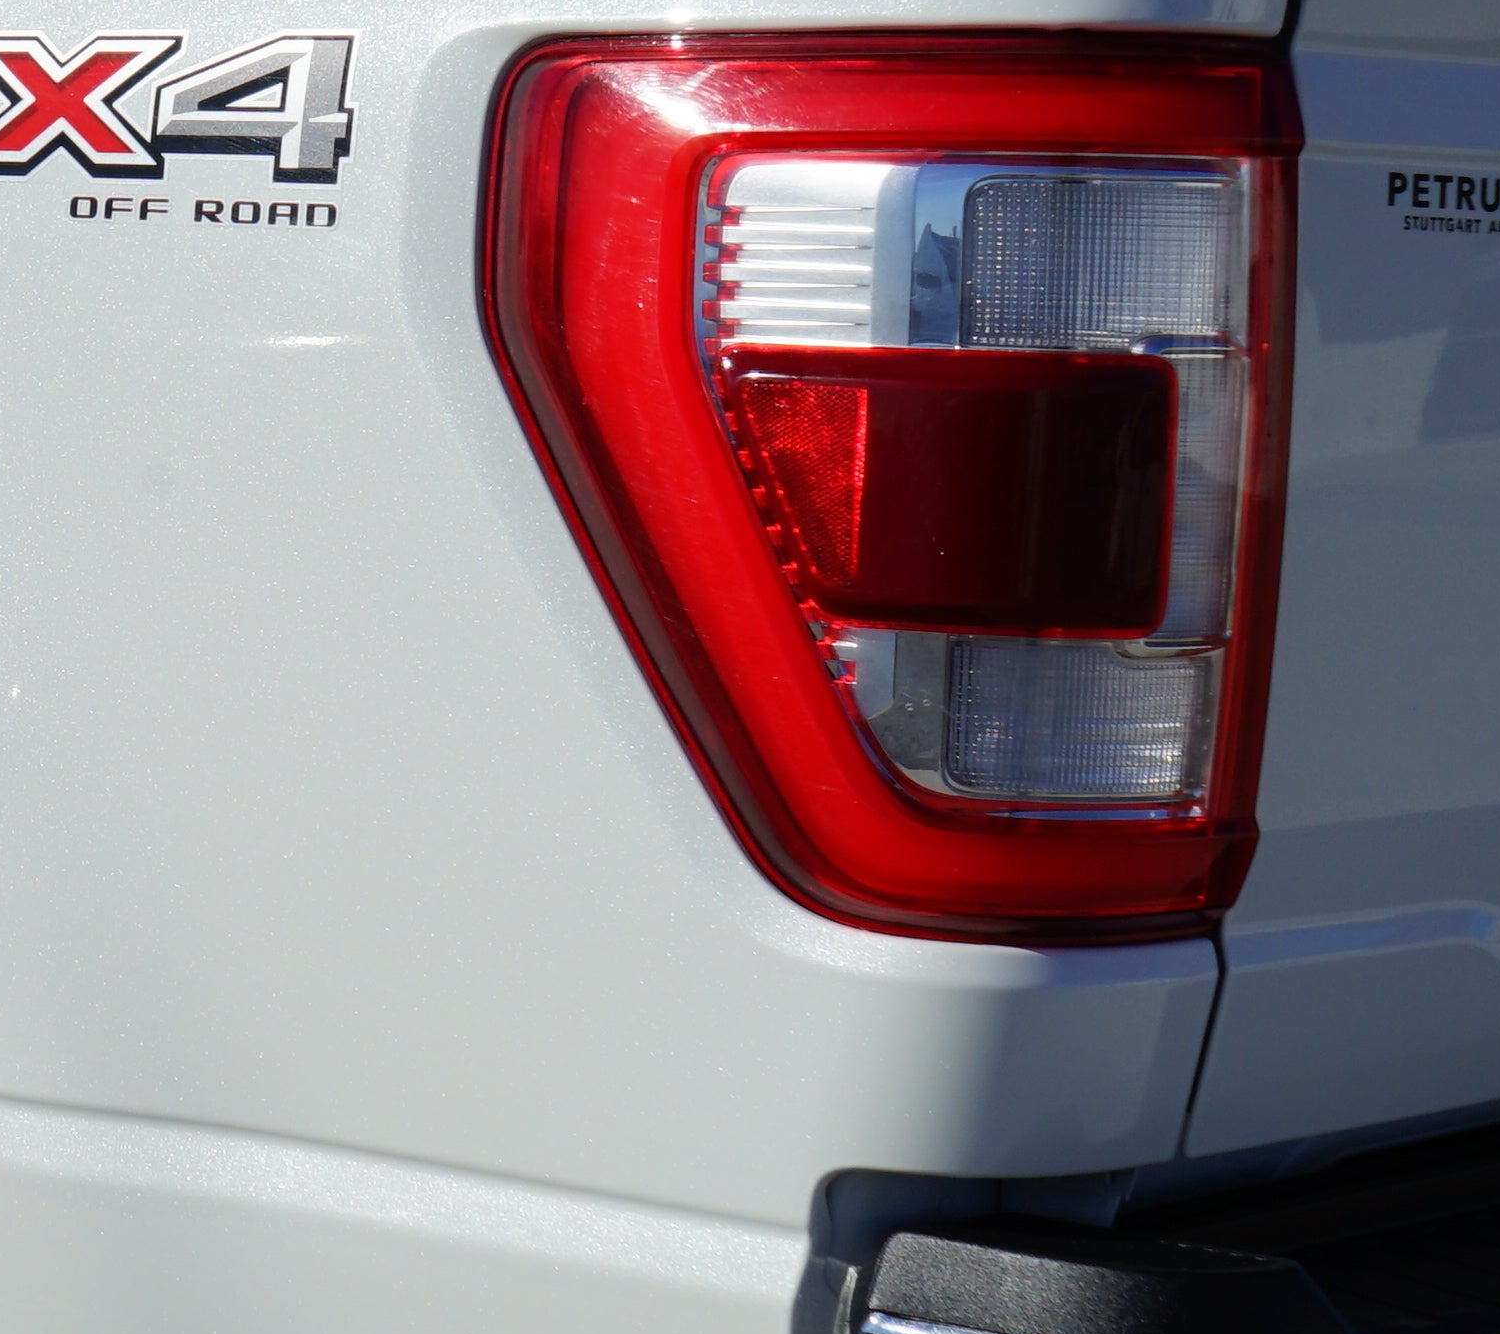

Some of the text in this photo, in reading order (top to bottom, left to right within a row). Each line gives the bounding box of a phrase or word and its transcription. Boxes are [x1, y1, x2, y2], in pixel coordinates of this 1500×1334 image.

[69, 195, 338, 227] OFF ROAD
[1403, 215, 1482, 234] STUTTGART
